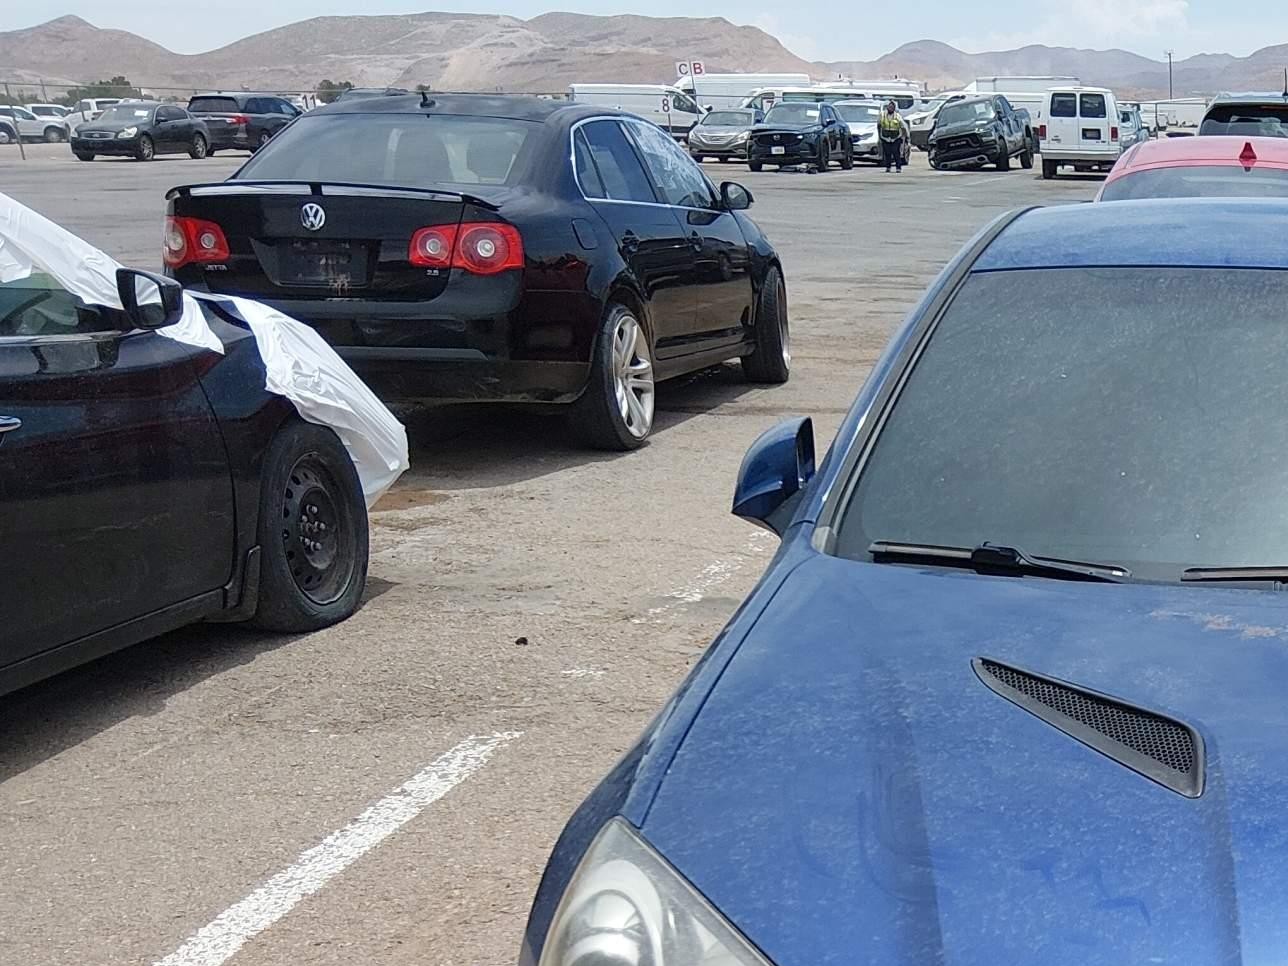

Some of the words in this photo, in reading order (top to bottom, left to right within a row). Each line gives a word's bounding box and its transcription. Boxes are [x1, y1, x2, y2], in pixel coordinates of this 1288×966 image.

[678, 63, 689, 75] C
[693, 62, 703, 75] B
[662, 98, 670, 113] 8
